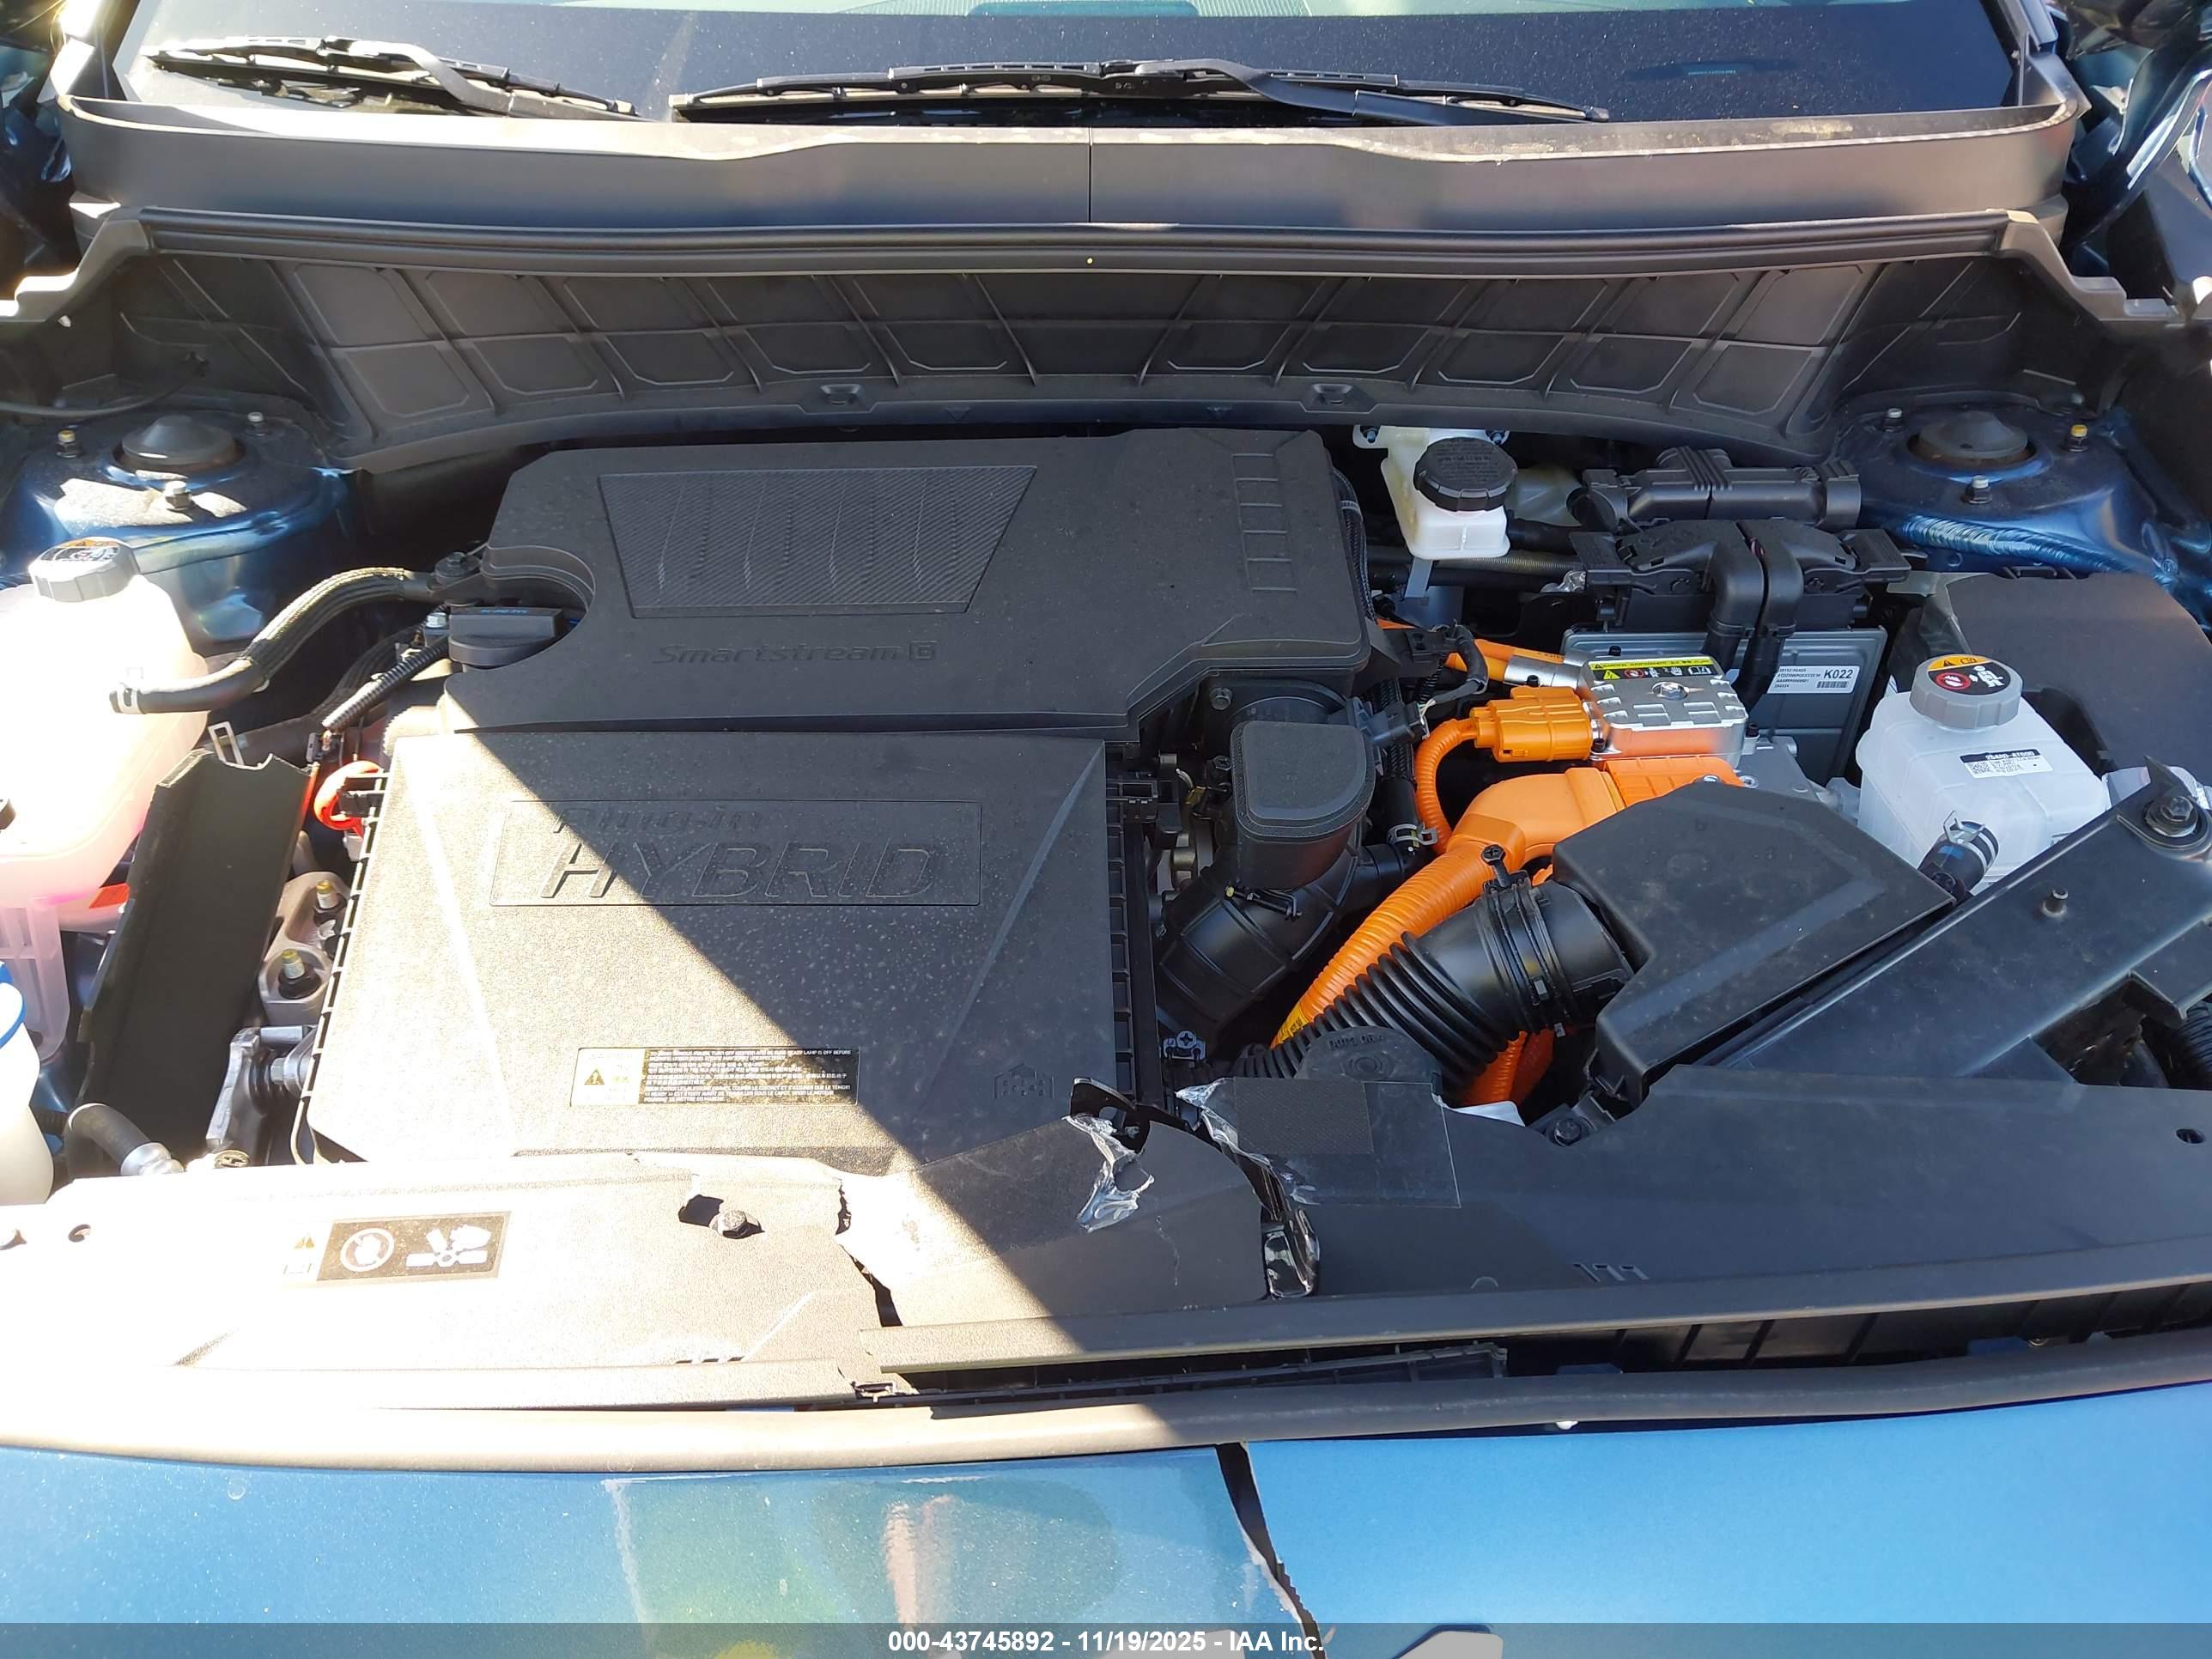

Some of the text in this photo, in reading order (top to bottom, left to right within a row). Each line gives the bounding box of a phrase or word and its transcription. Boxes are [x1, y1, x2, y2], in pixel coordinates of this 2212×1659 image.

[652, 642, 902, 665] Smartstream
[1823, 668, 1855, 679] K022
[539, 842, 934, 899] HYBRID
